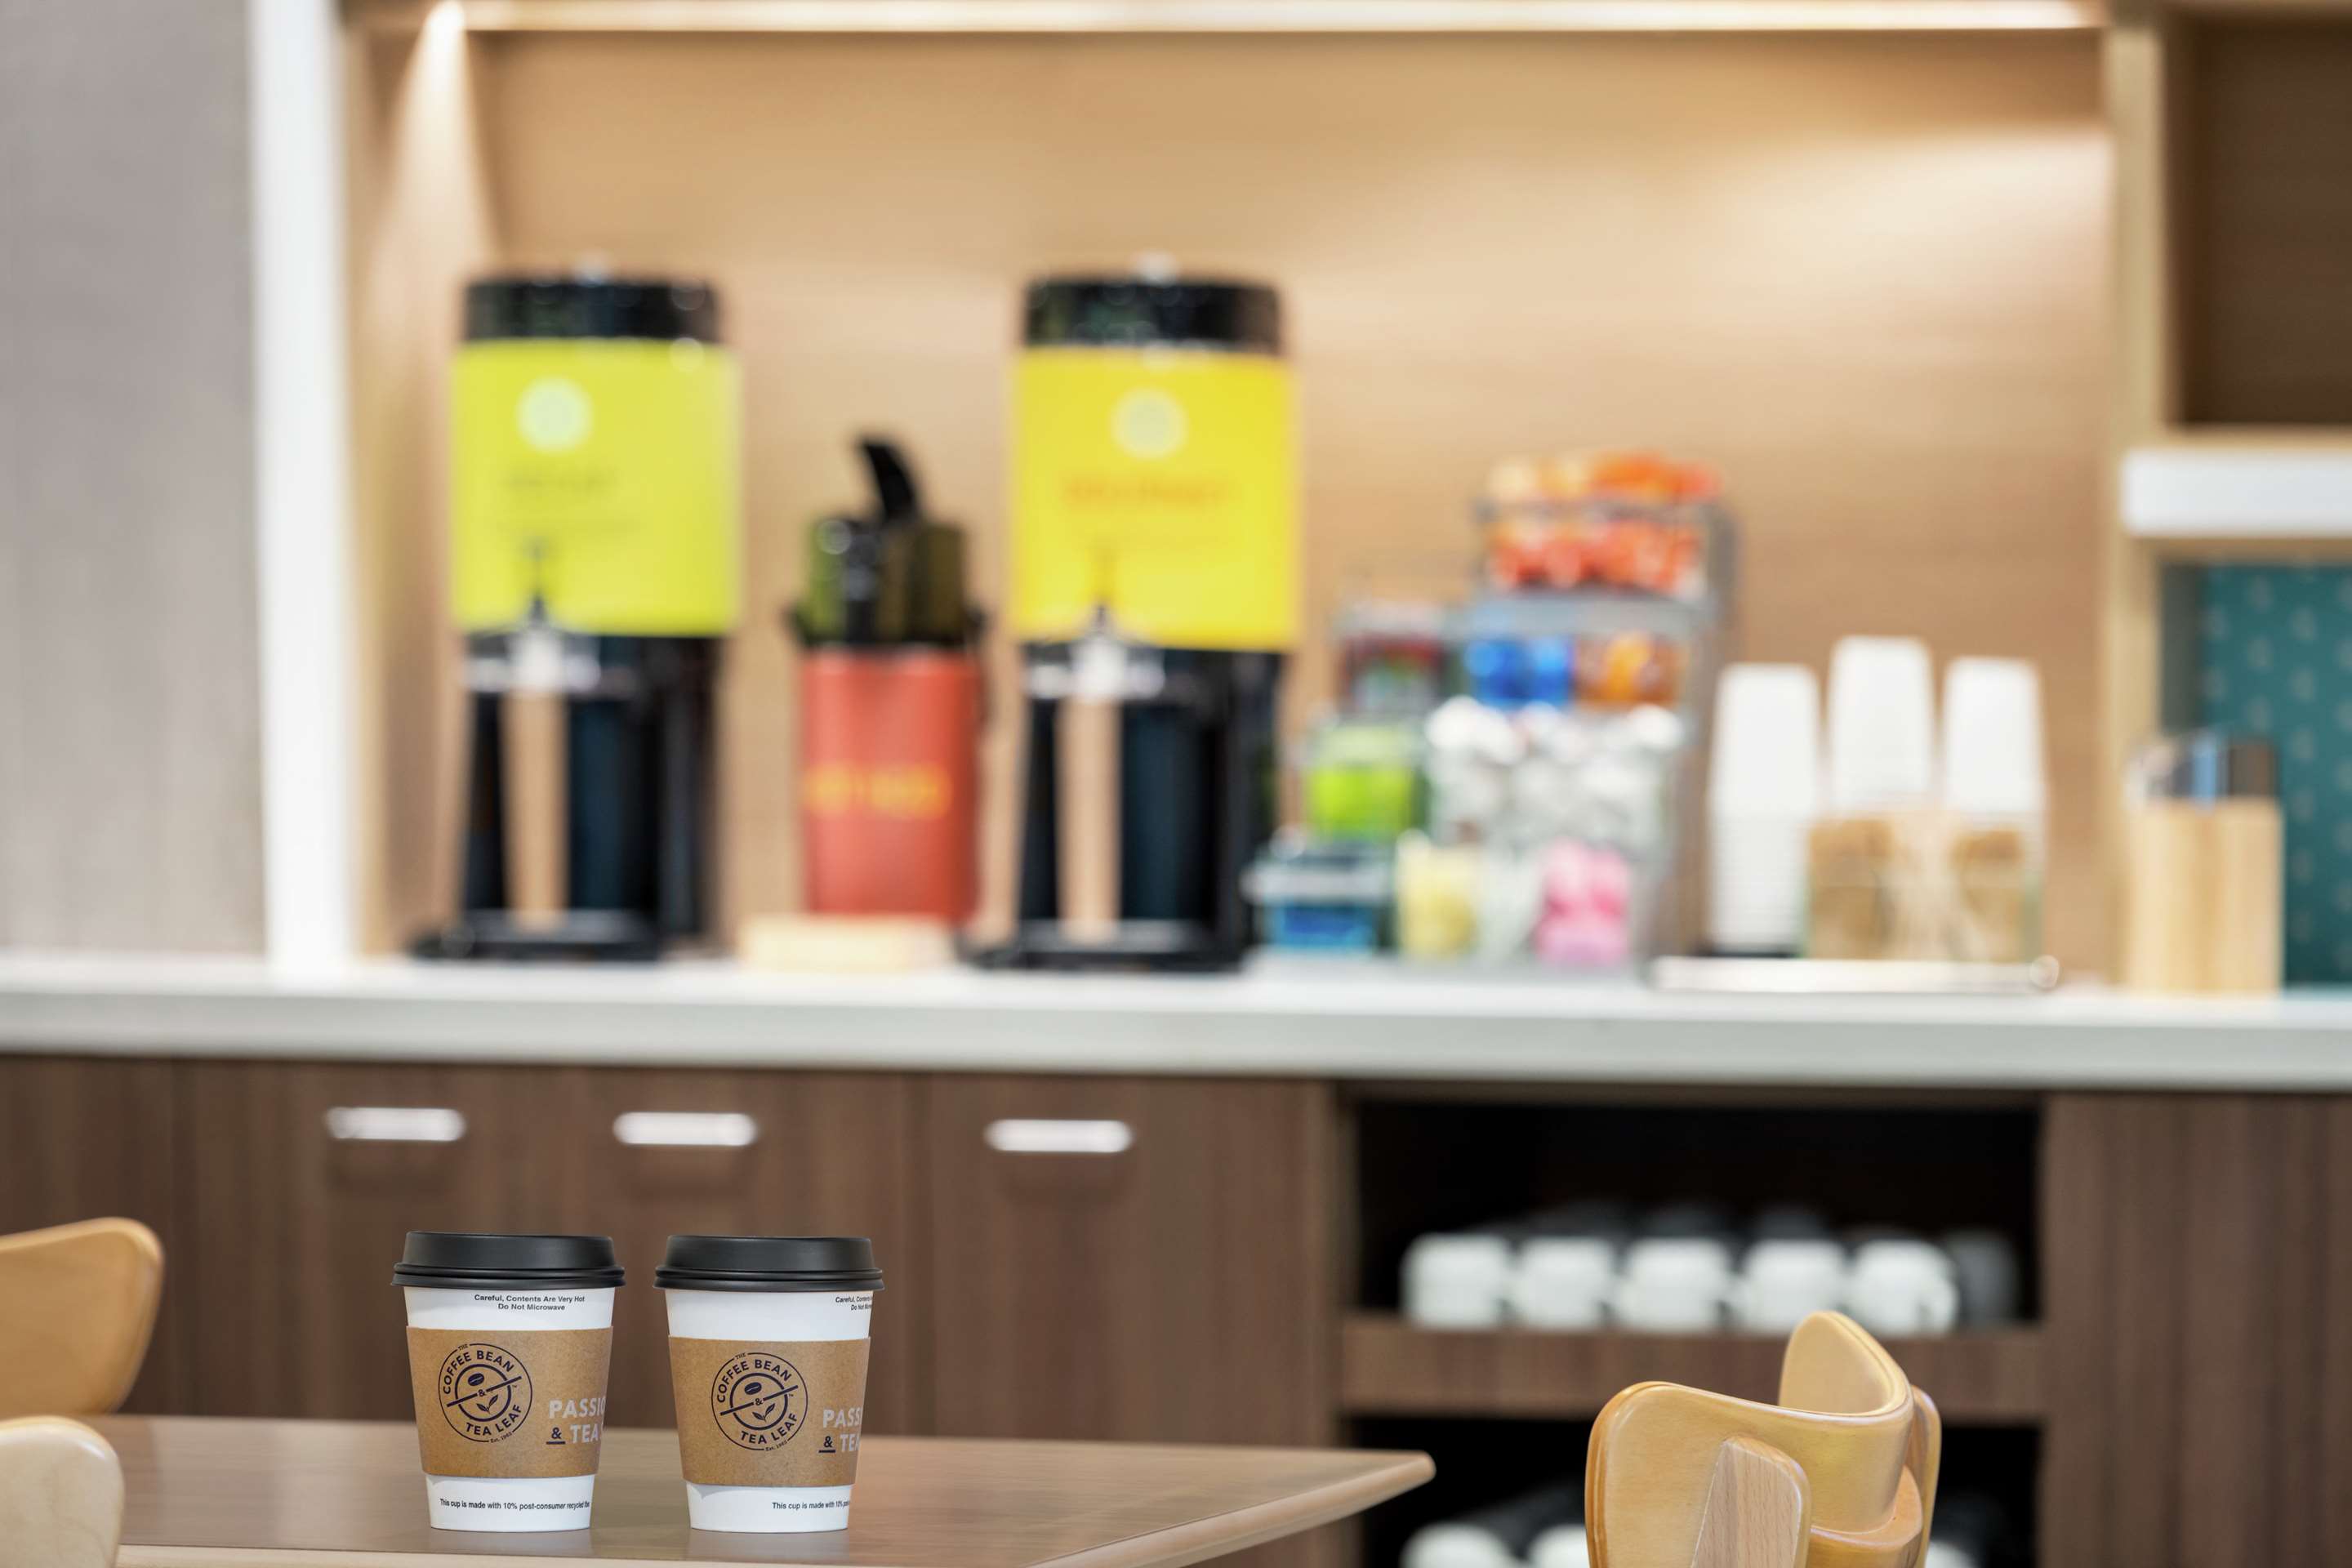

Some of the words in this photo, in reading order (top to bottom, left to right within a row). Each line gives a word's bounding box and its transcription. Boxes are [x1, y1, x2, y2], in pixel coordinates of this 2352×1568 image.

[474, 1294, 504, 1303] Careful,
[443, 1352, 472, 1395] COFFEE
[477, 1350, 514, 1373] BEAN
[716, 1361, 750, 1403] COFFEE
[755, 1359, 792, 1381] BEAN
[478, 1389, 486, 1397] &
[755, 1397, 764, 1405] &
[466, 1422, 492, 1436] TEA
[495, 1405, 522, 1432] LEAF
[551, 1427, 562, 1439] &
[741, 1431, 767, 1445] TEA
[770, 1413, 798, 1441] LEAF
[823, 1436, 833, 1448] &
[440, 1498, 450, 1507] This
[450, 1500, 461, 1508] cup
[487, 1501, 501, 1509] with
[519, 1502, 566, 1511] post-consumer
[788, 1503, 800, 1511] cup
